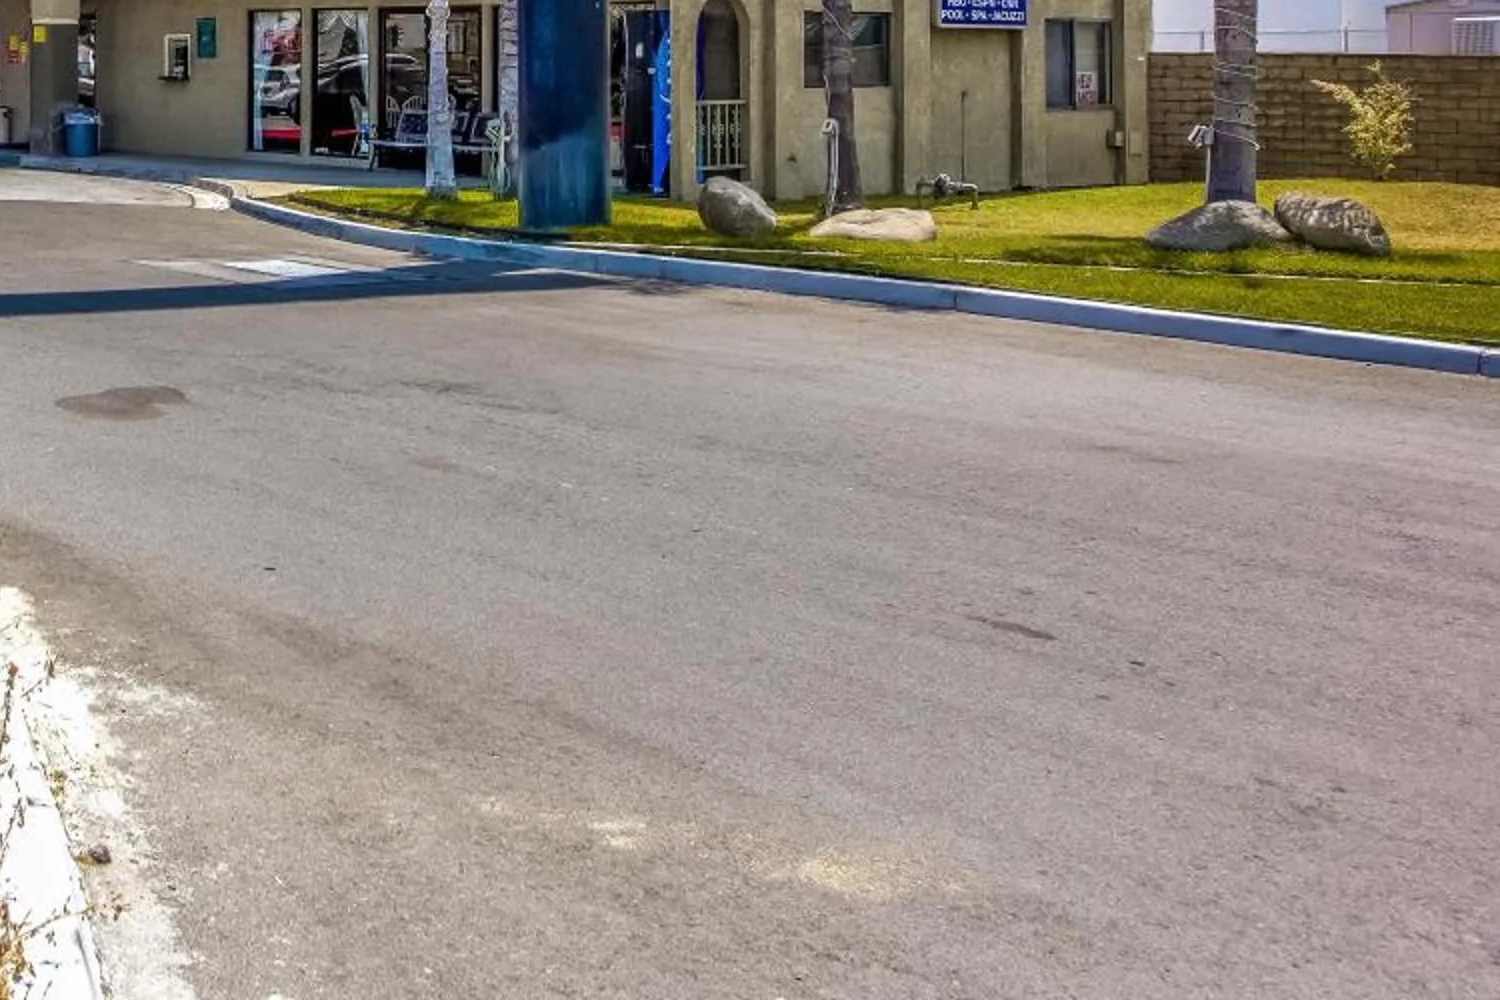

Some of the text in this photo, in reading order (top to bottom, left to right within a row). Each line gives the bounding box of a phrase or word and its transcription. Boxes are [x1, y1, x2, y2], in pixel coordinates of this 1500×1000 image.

[941, 9, 1025, 21] POOL SPA JACUZZI
